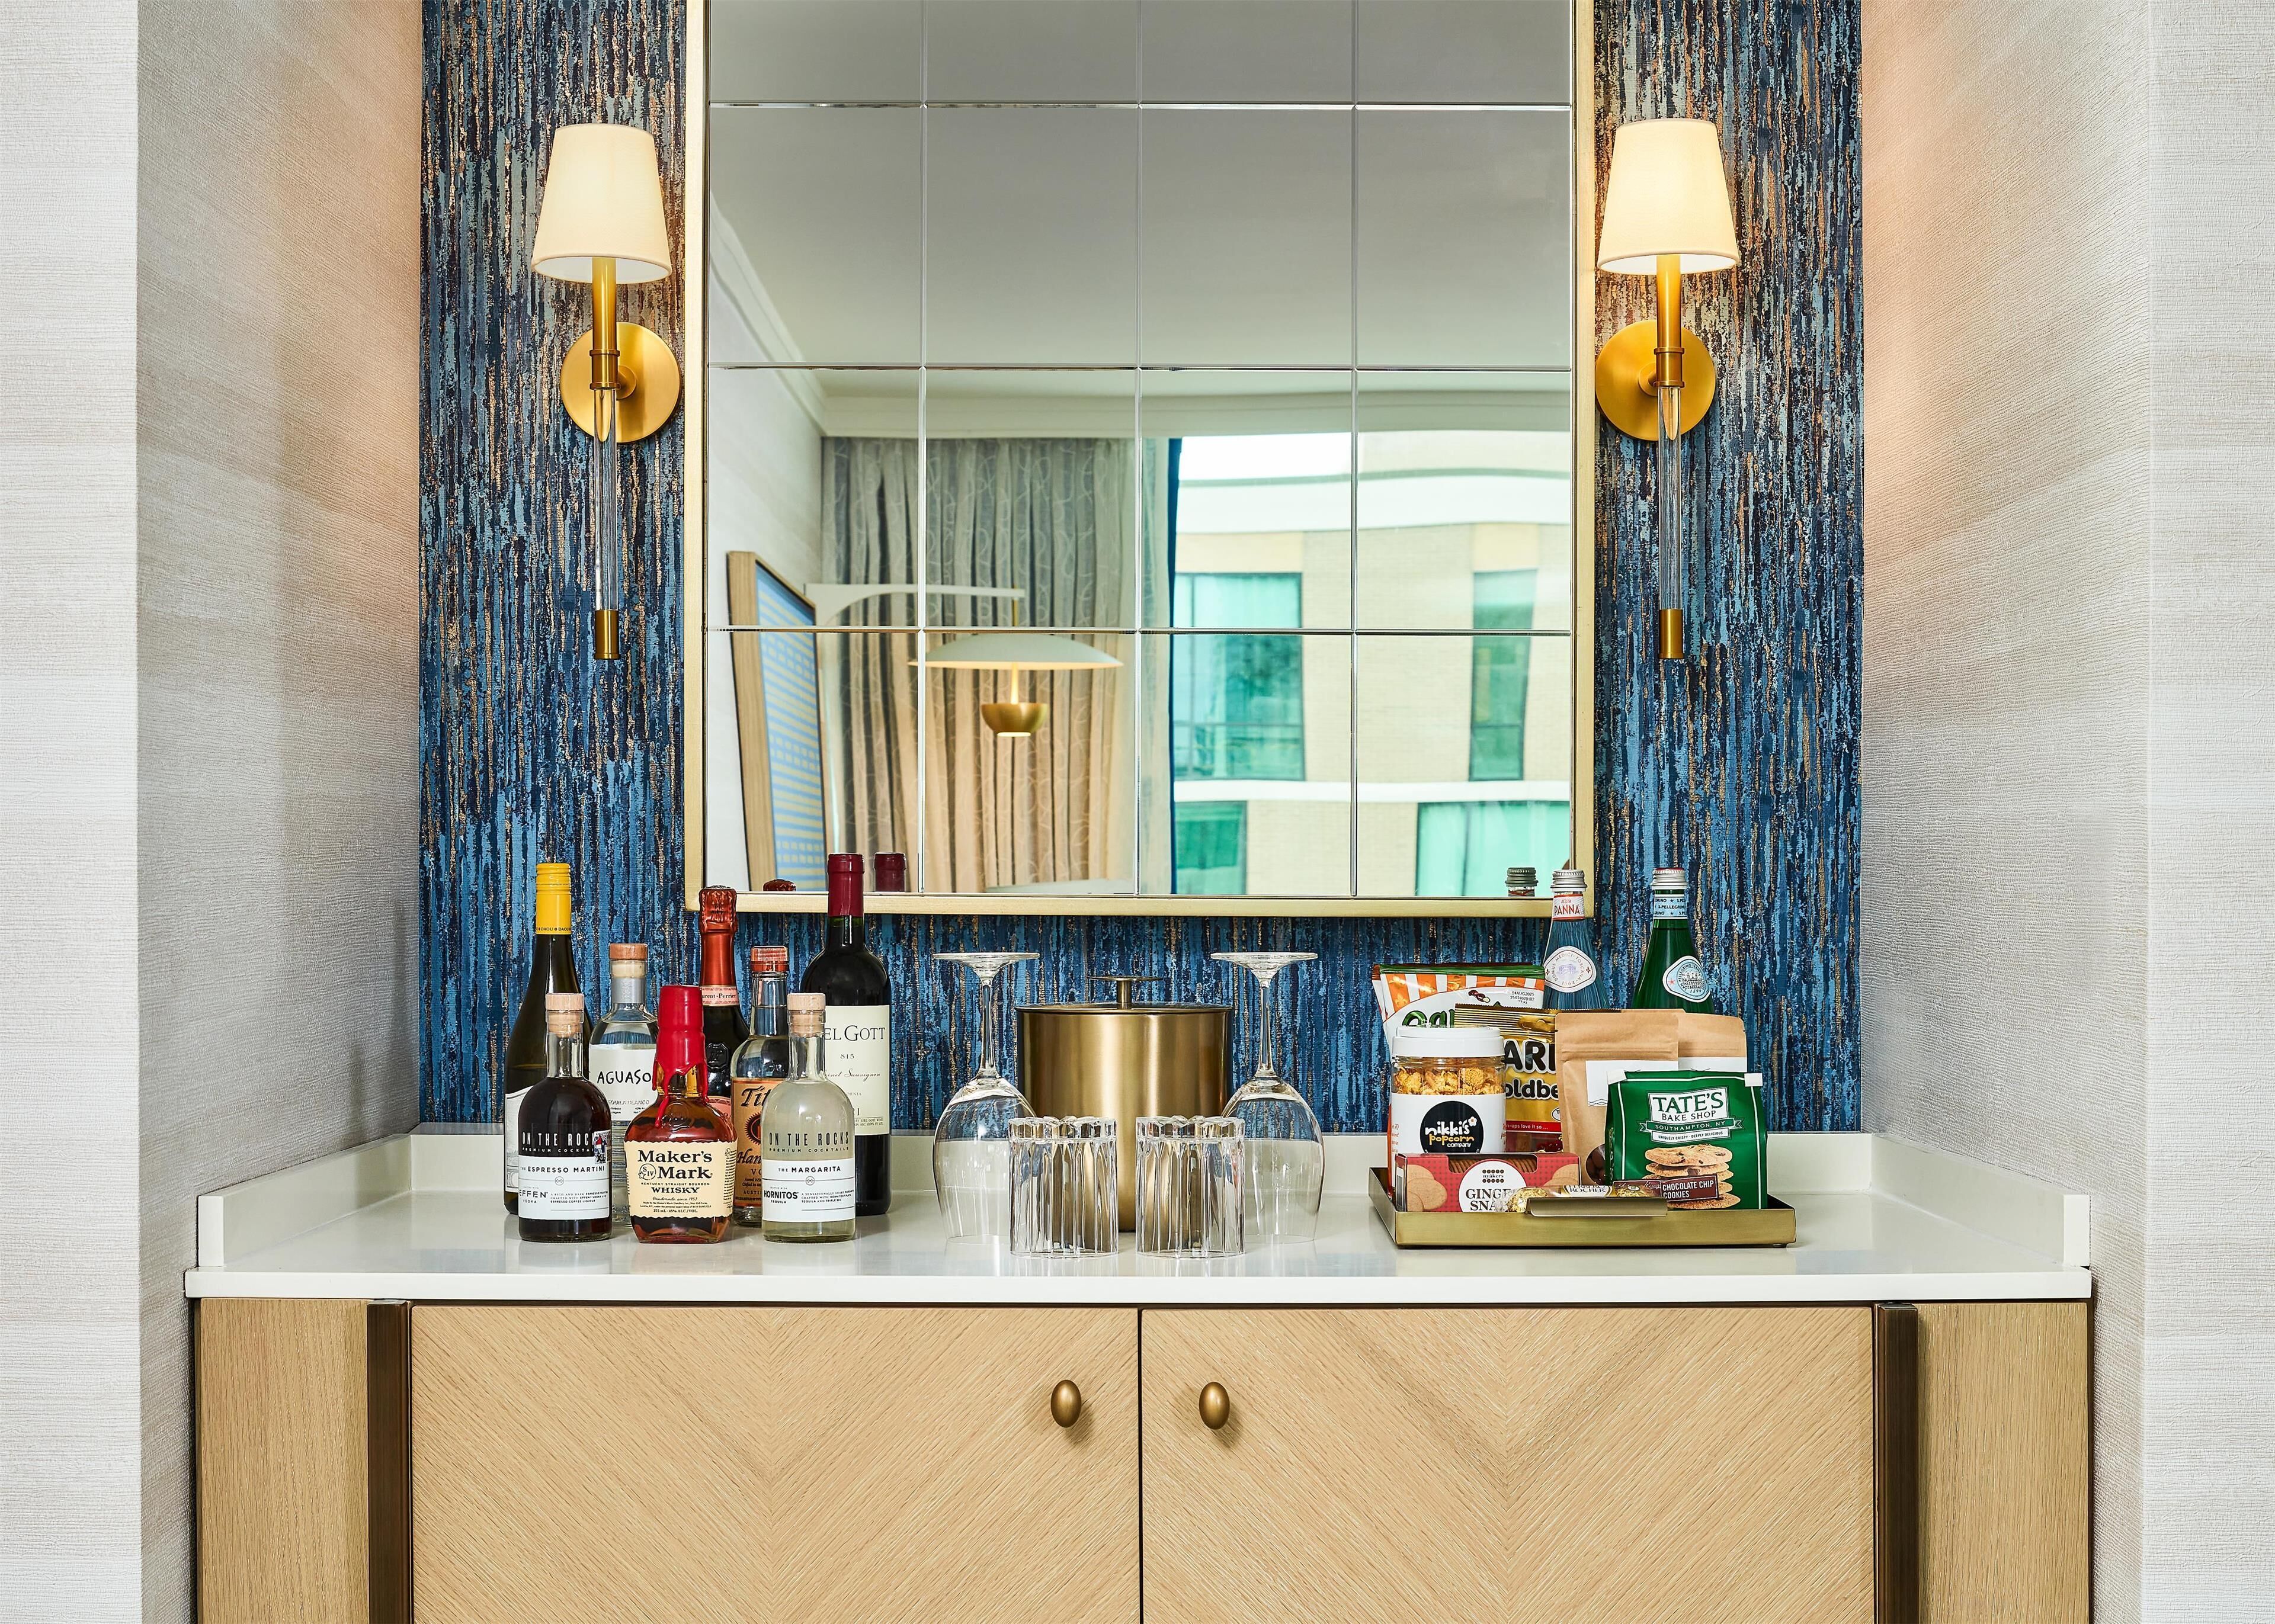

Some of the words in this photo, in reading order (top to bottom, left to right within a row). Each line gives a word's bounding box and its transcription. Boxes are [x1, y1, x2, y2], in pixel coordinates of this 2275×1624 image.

[1554, 904, 1580, 916] PANNA
[844, 1025, 885, 1041] GOTT
[843, 1068, 880, 1082] Sauvignon
[1652, 1092, 1723, 1114] TATE'S
[1661, 1113, 1687, 1122] BAKE
[1691, 1110, 1716, 1120] SHOP
[522, 1132, 531, 1145] ON
[538, 1133, 557, 1146] THE
[769, 1132, 779, 1145] ON
[787, 1133, 808, 1146] THE
[818, 1131, 849, 1146] ROCKS
[1428, 1134, 1475, 1145] popcorn
[637, 1150, 712, 1163] Maker's
[657, 1166, 712, 1179] Mark
[1662, 1181, 1698, 1192] CHOCOLATE
[1699, 1180, 1714, 1188] CHIP
[519, 1189, 547, 1198] EFFEN
[764, 1190, 798, 1199] HORNITOS
[1663, 1190, 1690, 1199] COOKIES
